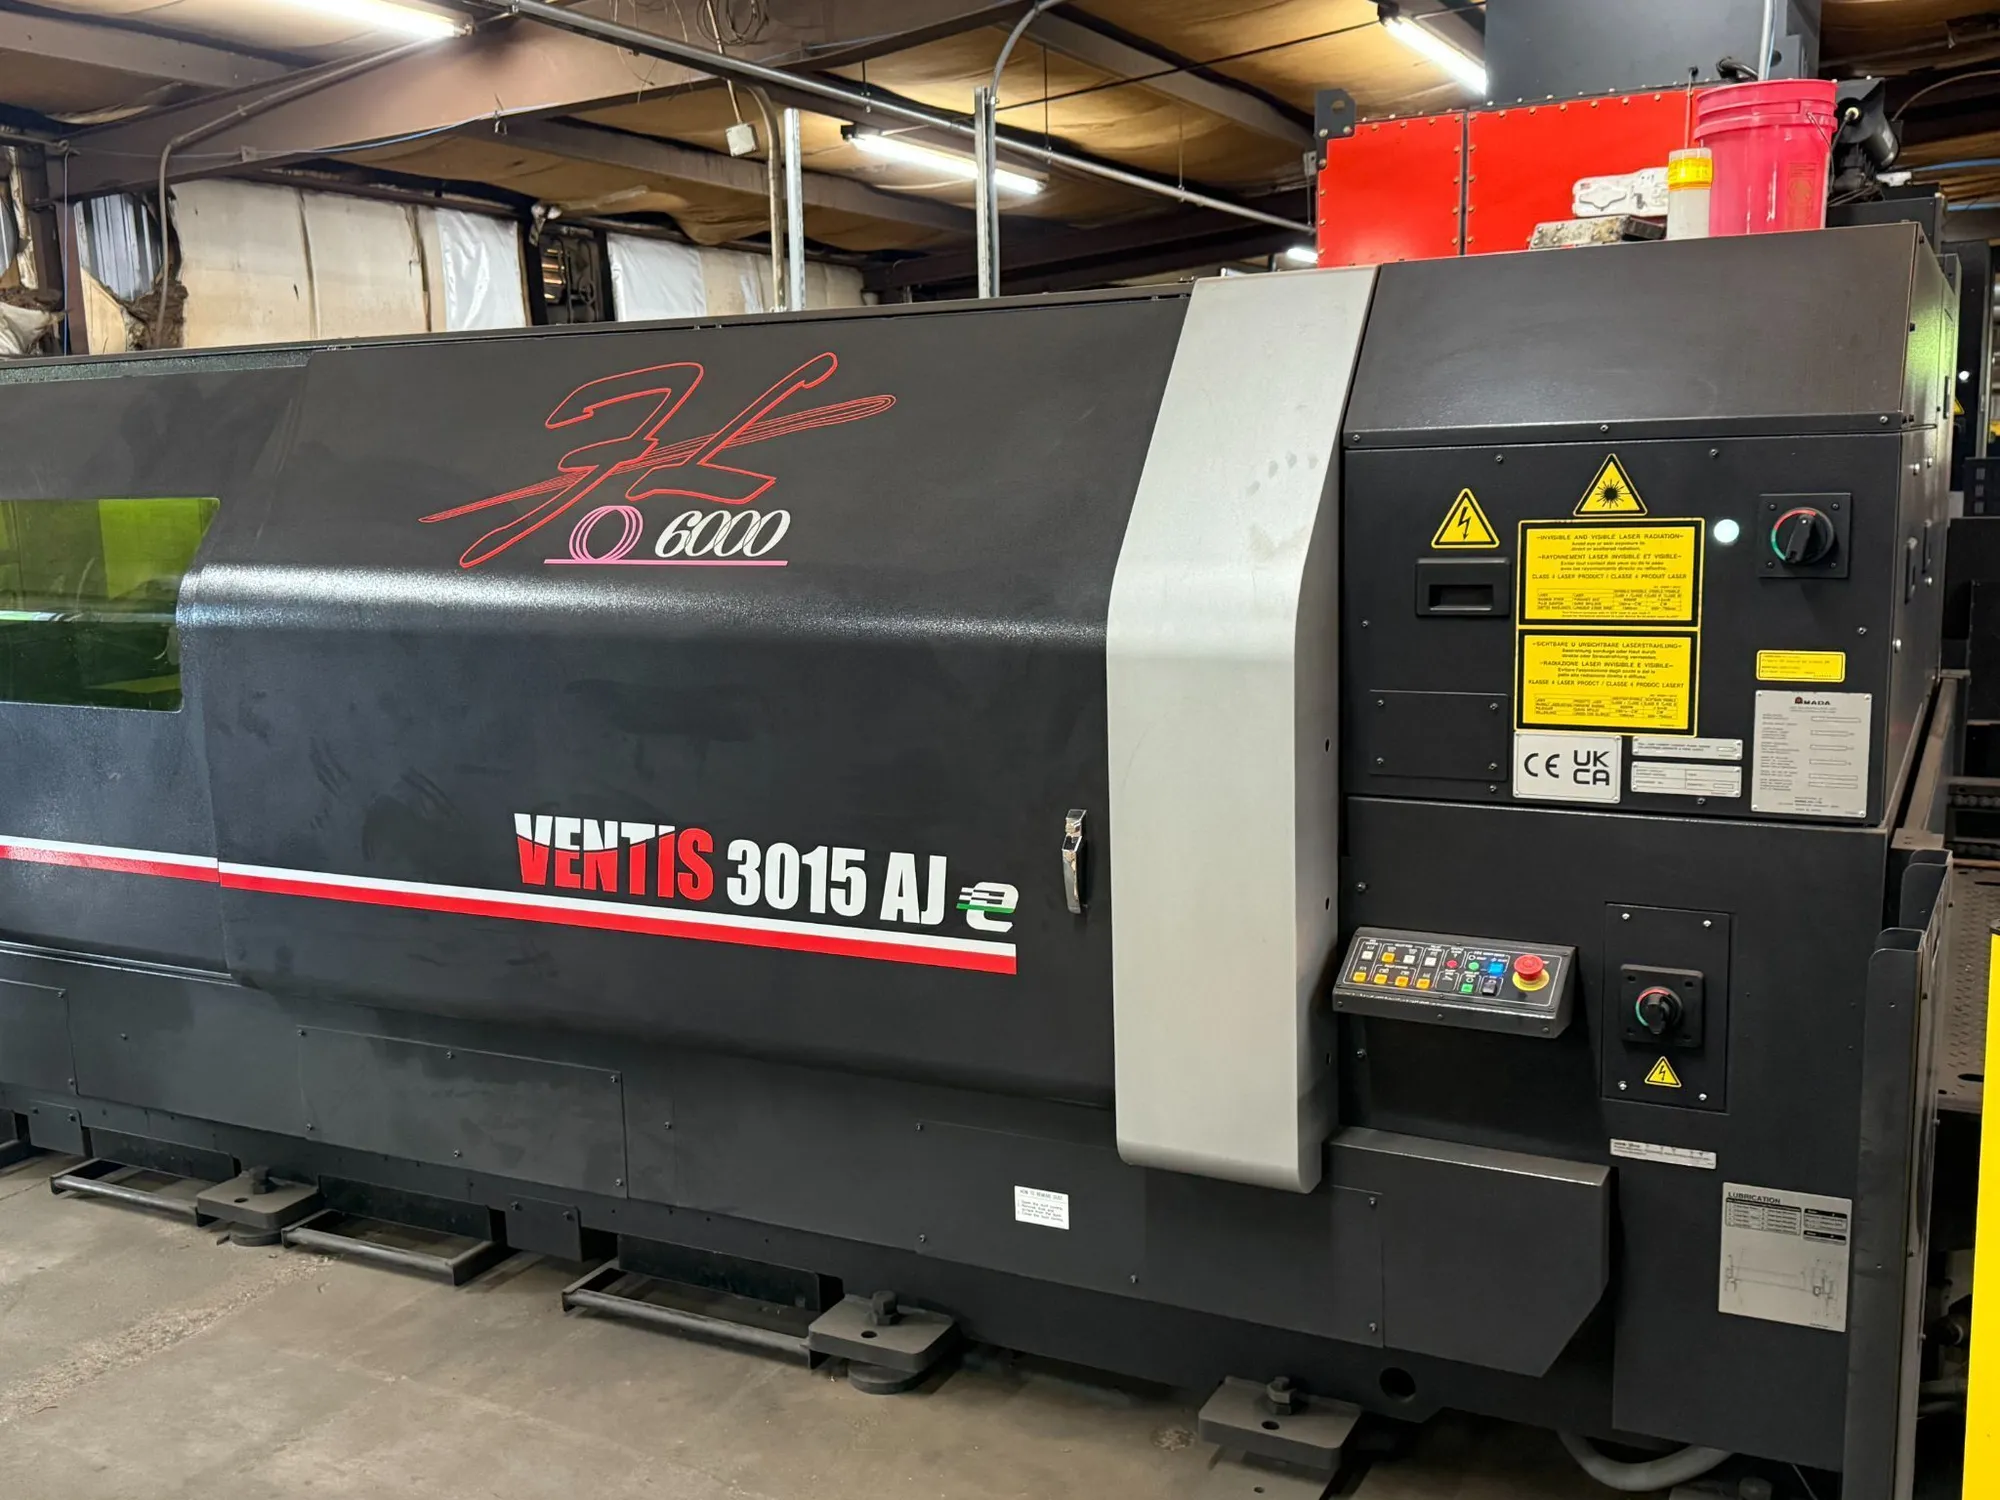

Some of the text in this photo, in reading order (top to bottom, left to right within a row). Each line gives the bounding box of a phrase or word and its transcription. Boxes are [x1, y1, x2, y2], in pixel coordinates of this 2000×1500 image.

[654, 509, 791, 558] 6000
[1795, 696, 1831, 705] AMADA
[1524, 752, 1560, 778] CE
[1573, 750, 1610, 767] UK
[1573, 769, 1610, 786] CA
[513, 813, 715, 901] VENTIS
[726, 839, 867, 917] 3015
[879, 852, 947, 926] AJ
[1728, 1192, 1781, 1203] LUBRICATION
